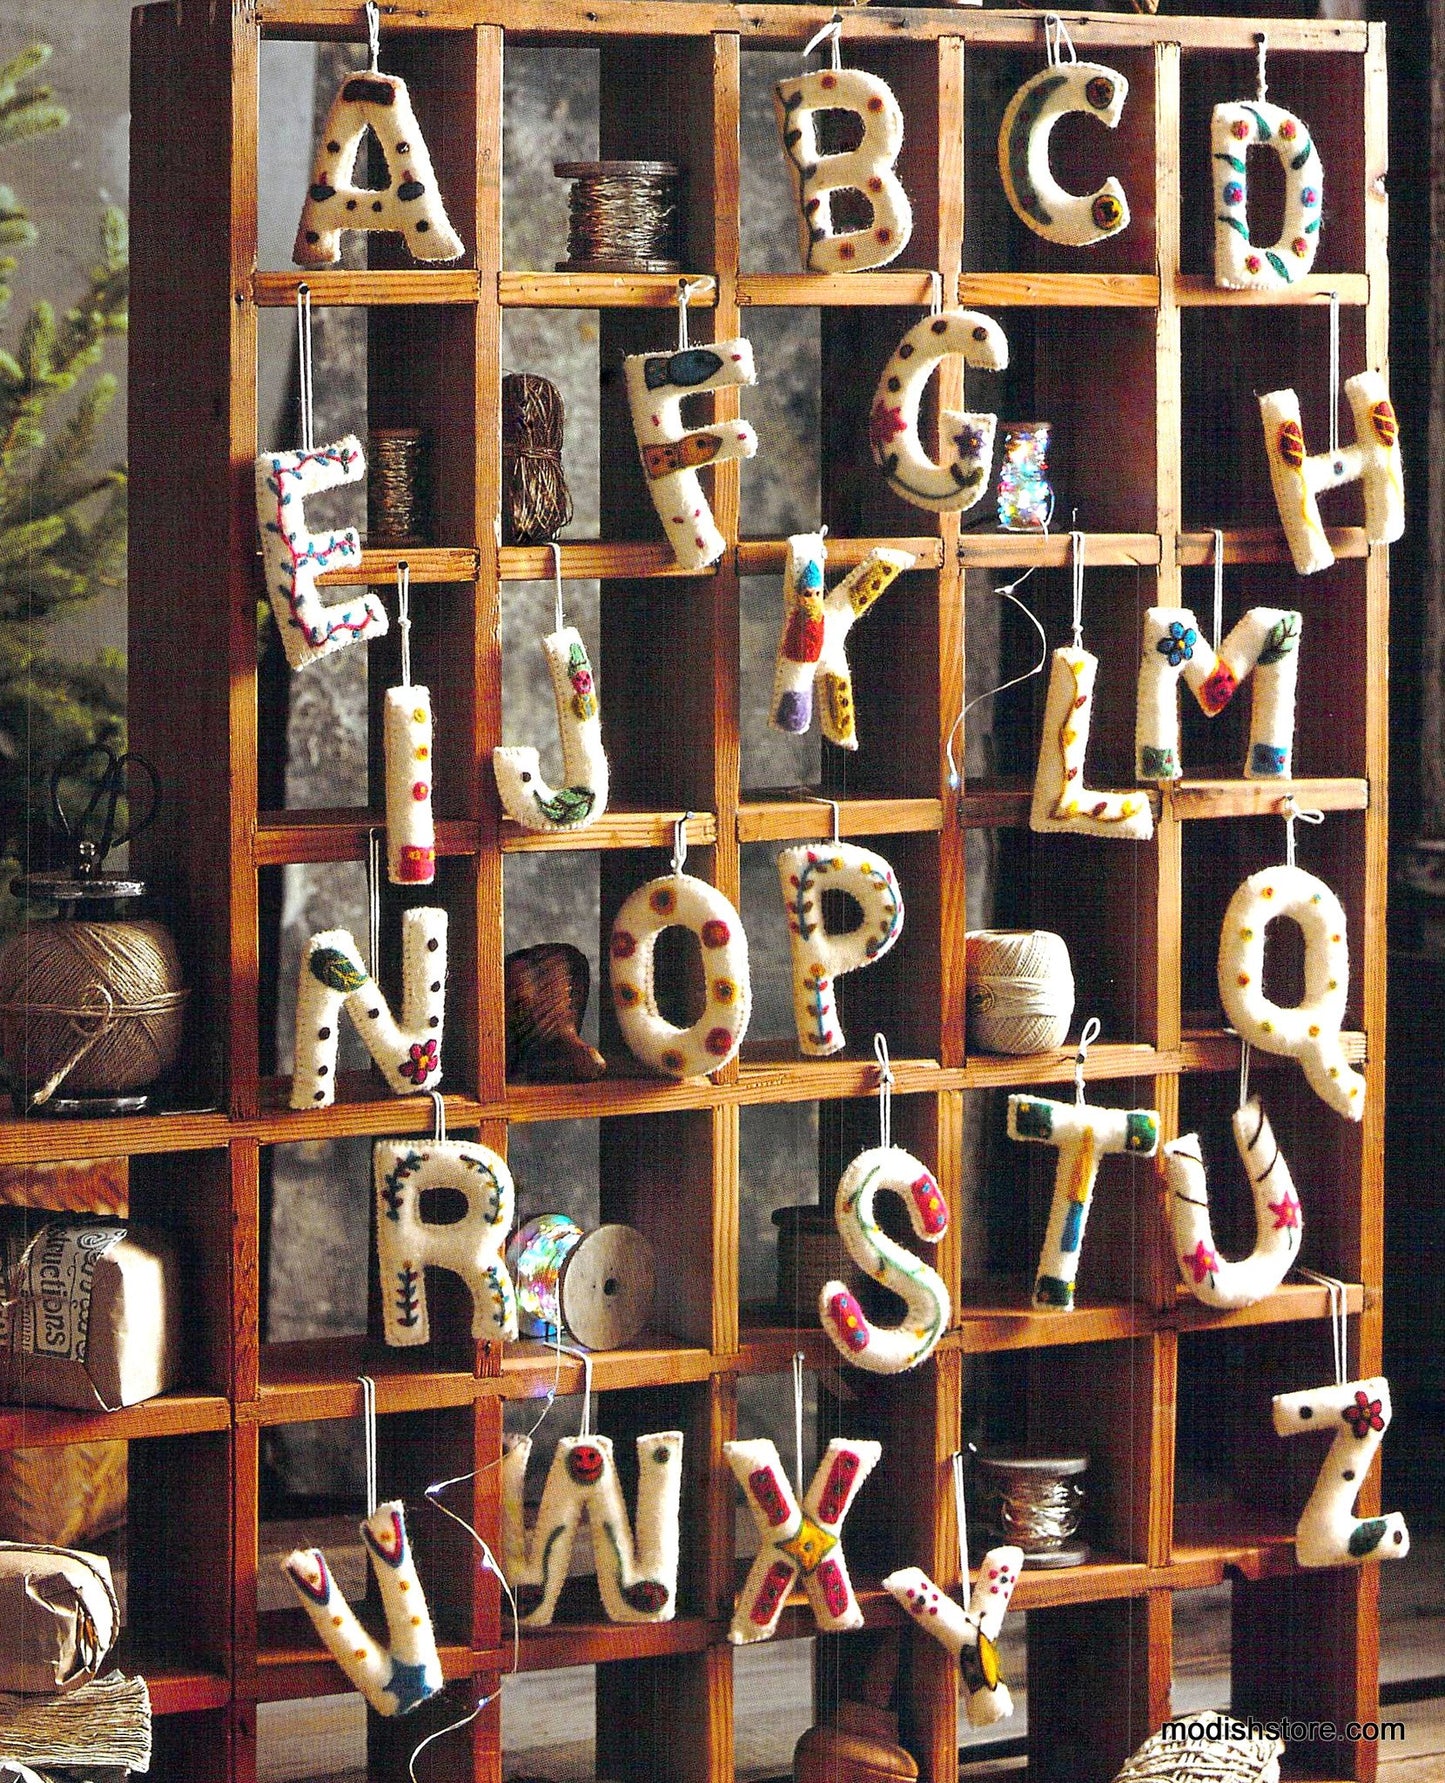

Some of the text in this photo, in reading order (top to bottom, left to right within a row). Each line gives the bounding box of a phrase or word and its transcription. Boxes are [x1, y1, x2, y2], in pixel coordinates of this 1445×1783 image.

[292, 70, 466, 265] A
[775, 68, 914, 272] B
[999, 61, 1130, 246] C
[1211, 101, 1324, 290] D
[622, 335, 758, 570] F
[870, 309, 1009, 512] G
[1257, 369, 1407, 575] H
[254, 433, 390, 672] E
[768, 530, 917, 751] K
[384, 685, 436, 884] I
[492, 626, 610, 831] J
[1029, 645, 1154, 842] L
[1135, 606, 1303, 782] M
[289, 905, 449, 1110] N
[609, 873, 753, 1081] O
[777, 841, 905, 1056] P
[1216, 863, 1367, 1122] Q
[373, 1138, 519, 1348] R
[819, 1146, 952, 1375] S
[1006, 1093, 1162, 1312] T
[1163, 1097, 1304, 1309] U
[502, 1431, 684, 1625] W
[723, 1437, 883, 1646] X
[1272, 1375, 1411, 1569] Z
[280, 1500, 444, 1717] V
[881, 1545, 1025, 1726] Y
